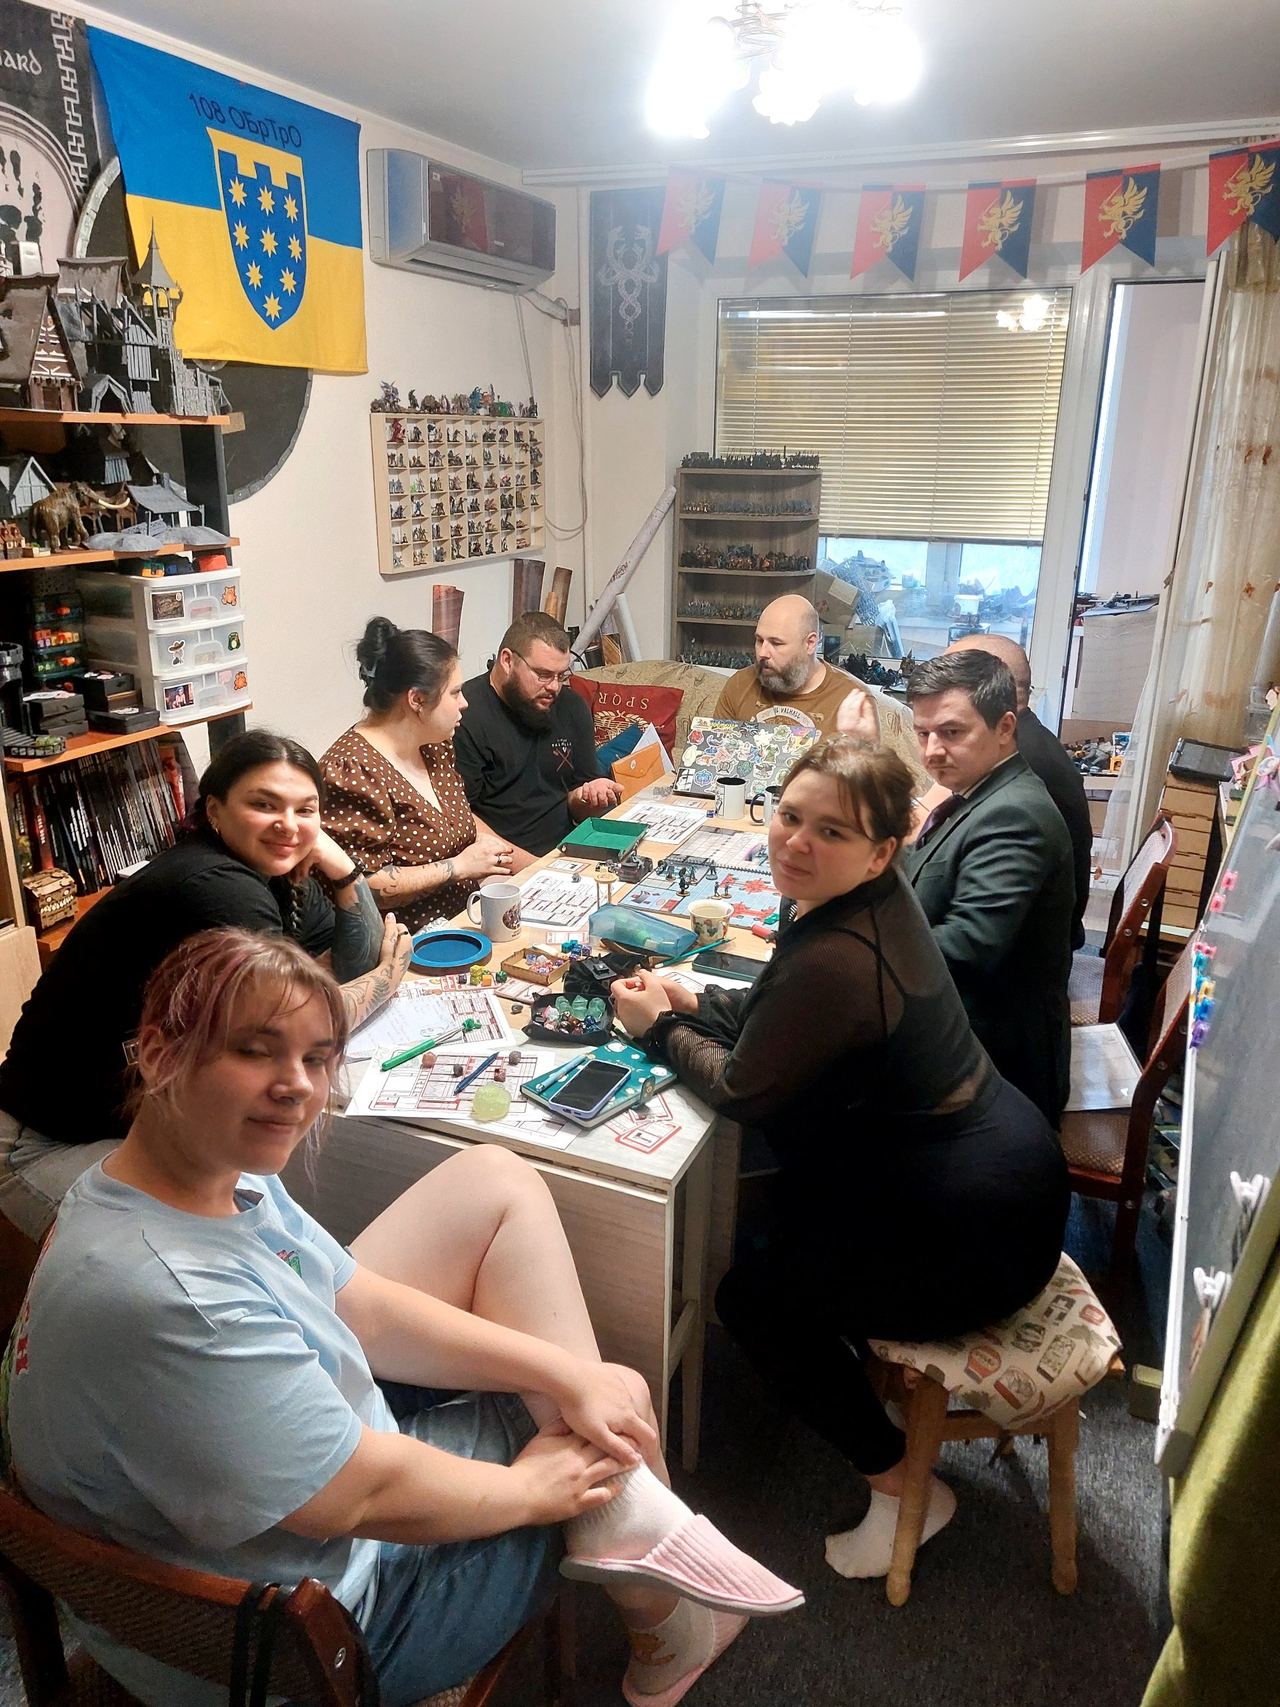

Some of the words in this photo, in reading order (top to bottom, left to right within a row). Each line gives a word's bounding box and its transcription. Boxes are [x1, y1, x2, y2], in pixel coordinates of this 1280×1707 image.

[189, 93, 226, 125] 108
[228, 106, 302, 149] ОБрТрО
[598, 691, 650, 710] SPQR
